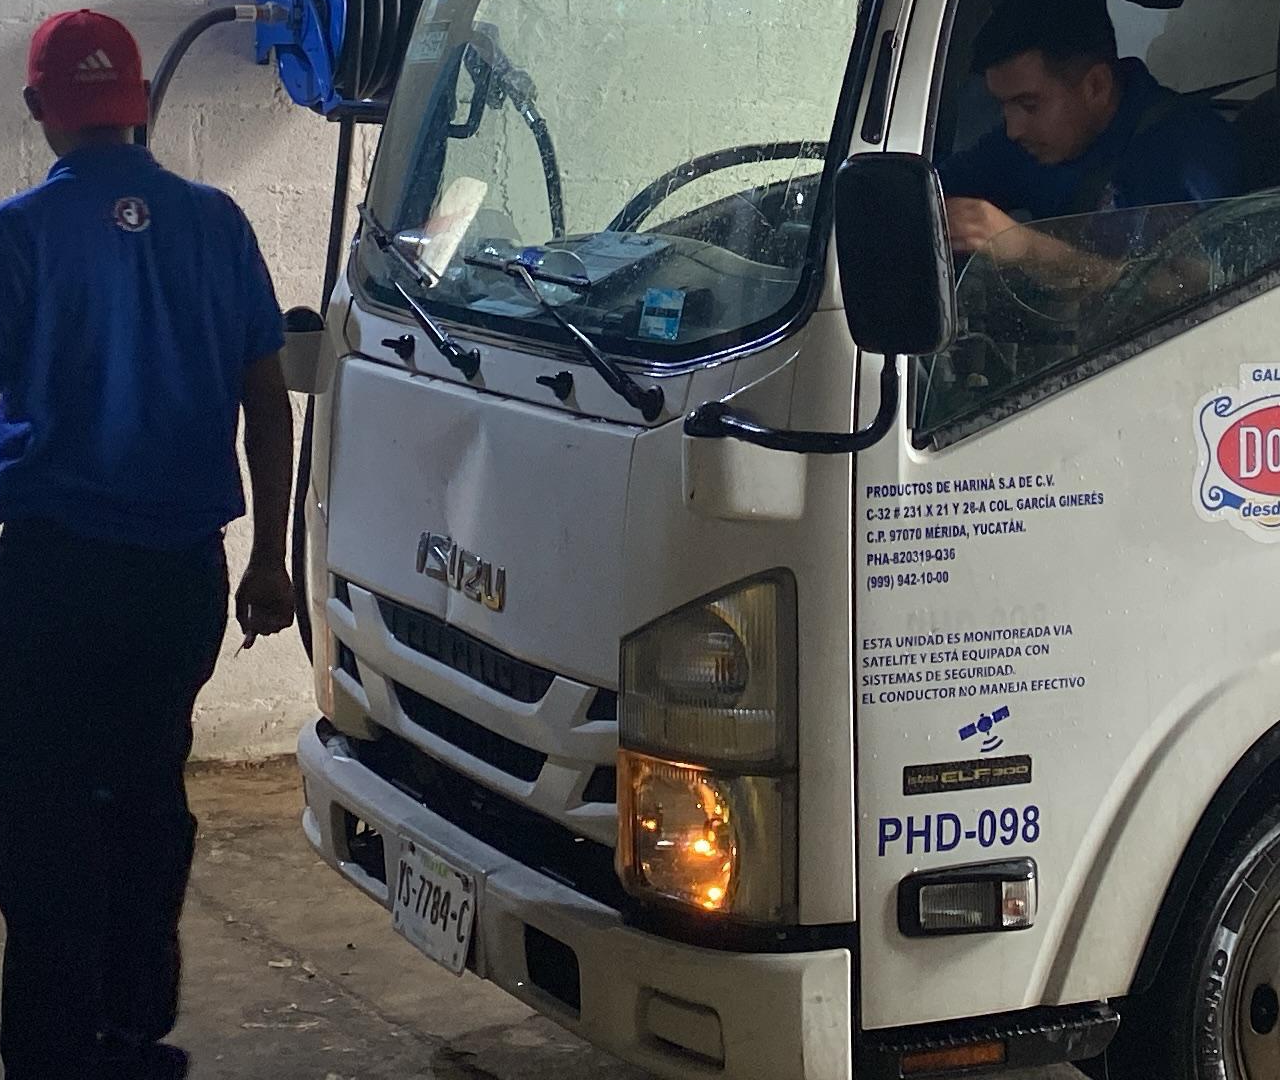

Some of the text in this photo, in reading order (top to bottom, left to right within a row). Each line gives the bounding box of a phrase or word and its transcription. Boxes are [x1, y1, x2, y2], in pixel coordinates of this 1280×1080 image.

[866, 482, 933, 499] PRODUCTOS
[936, 480, 951, 494] DE
[953, 477, 996, 493] HARINA
[1019, 475, 1033, 489] DE
[1035, 474, 1056, 488] C.V.
[866, 504, 891, 521] C-32
[903, 504, 923, 519] 231
[926, 504, 935, 518] X
[936, 503, 949, 517] 21
[952, 502, 960, 516] Y
[989, 498, 1015, 513] COL.
[1016, 493, 1057, 511] GARCÍA
[1058, 490, 1105, 509] GINERÉS
[866, 519, 1027, 545] C.P. 97070 MÉRIDA, YUCATÁN.
[415, 530, 507, 614] ISUZU
[866, 570, 950, 592] (999) 942-10-00
[862, 624, 1074, 651] ESTA UNIDAD ES MONITOREADA VIA
[862, 643, 1051, 669] SATELITE Y ESTÁ EQUIPADA CON
[862, 664, 1017, 688] SISTEMAS DE SEGURIDAD.
[861, 676, 1087, 706] EL CONDUCTOR NO MANEJA EFECTIVO
[877, 804, 1041, 858] PHD-098
[397, 858, 471, 944] YS-7784-C
